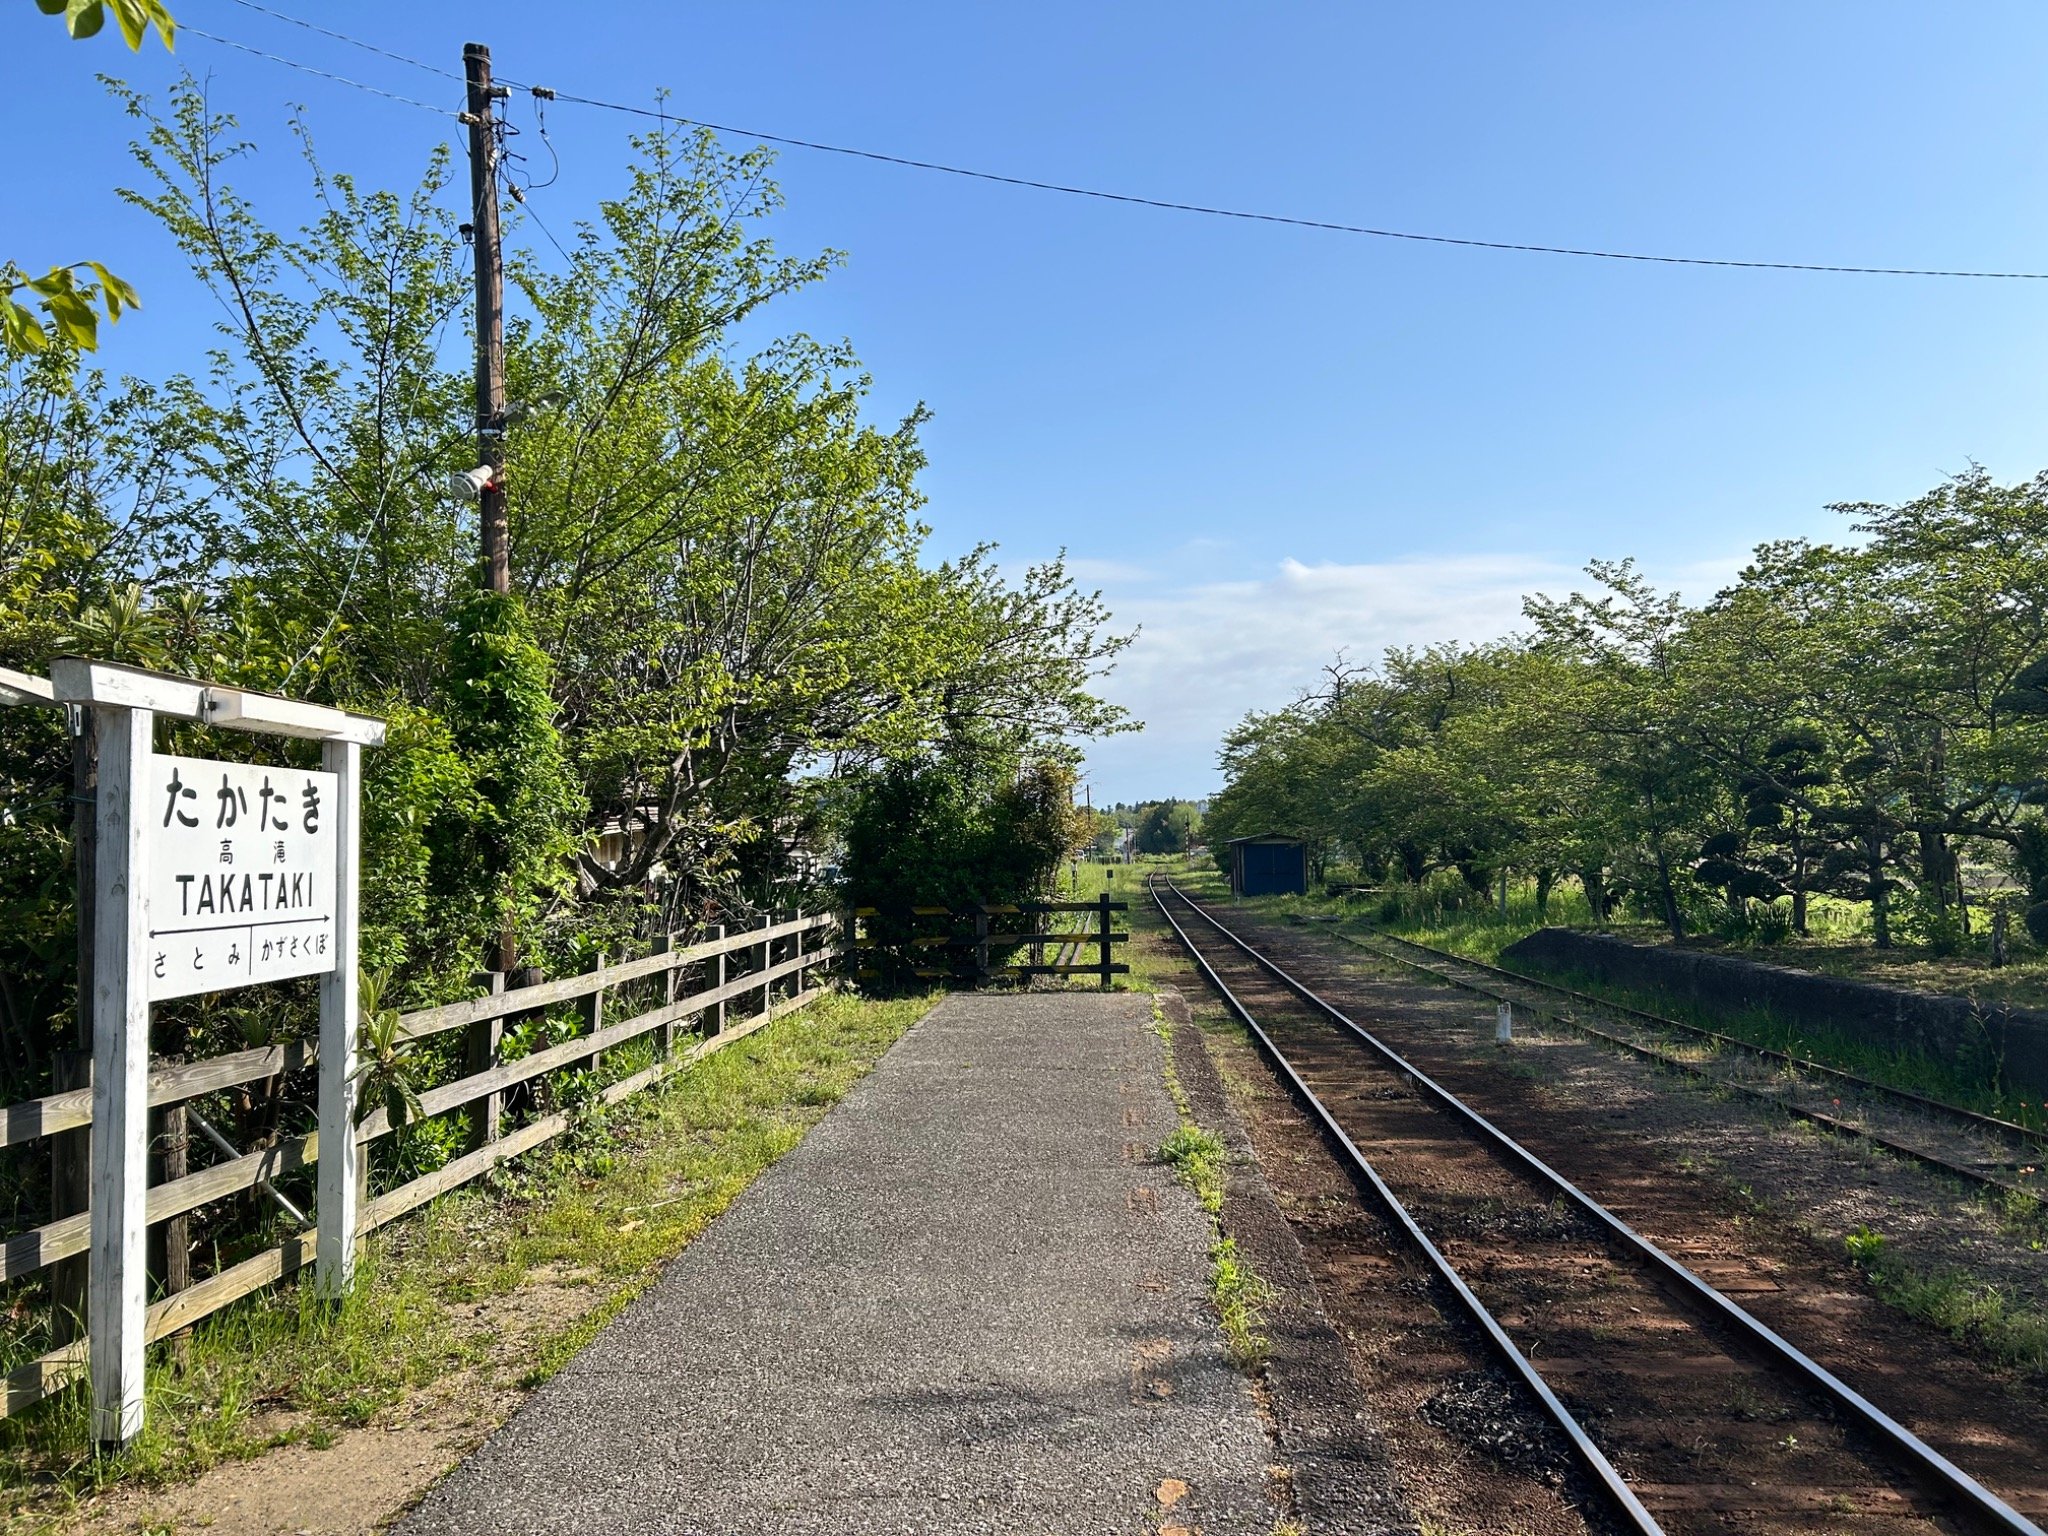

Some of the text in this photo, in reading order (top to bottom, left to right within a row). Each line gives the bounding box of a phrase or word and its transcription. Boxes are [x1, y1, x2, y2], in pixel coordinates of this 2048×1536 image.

[163, 767, 320, 834] たかたき
[219, 838, 286, 865] 高滝
[175, 872, 313, 916] TAKATAKI
[154, 943, 240, 978] さとみ
[261, 933, 329, 962] かずさくぼ
